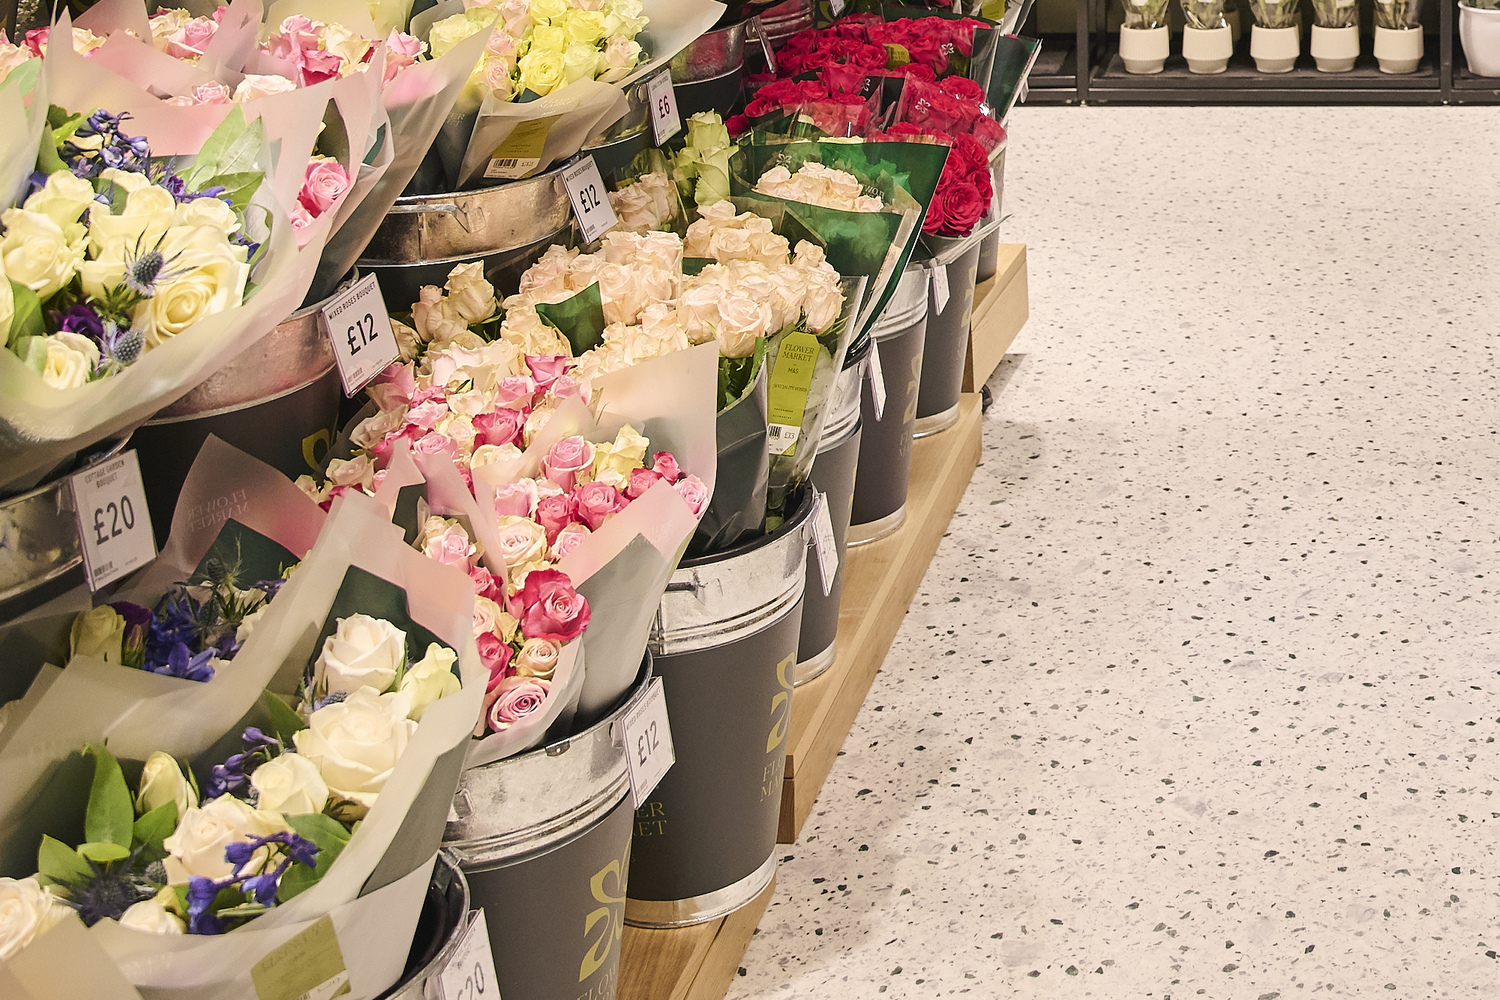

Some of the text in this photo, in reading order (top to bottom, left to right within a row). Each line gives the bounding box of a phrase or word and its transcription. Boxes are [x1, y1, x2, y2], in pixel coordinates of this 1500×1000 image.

[658, 95, 670, 119] £6
[579, 184, 600, 214] £12
[328, 281, 376, 320] MIXED ROSES BOUQUET
[347, 312, 379, 356] £12
[784, 343, 815, 355] FLOWER
[782, 350, 813, 362] MARKET
[94, 495, 135, 546] £20
[638, 720, 659, 767] £12
